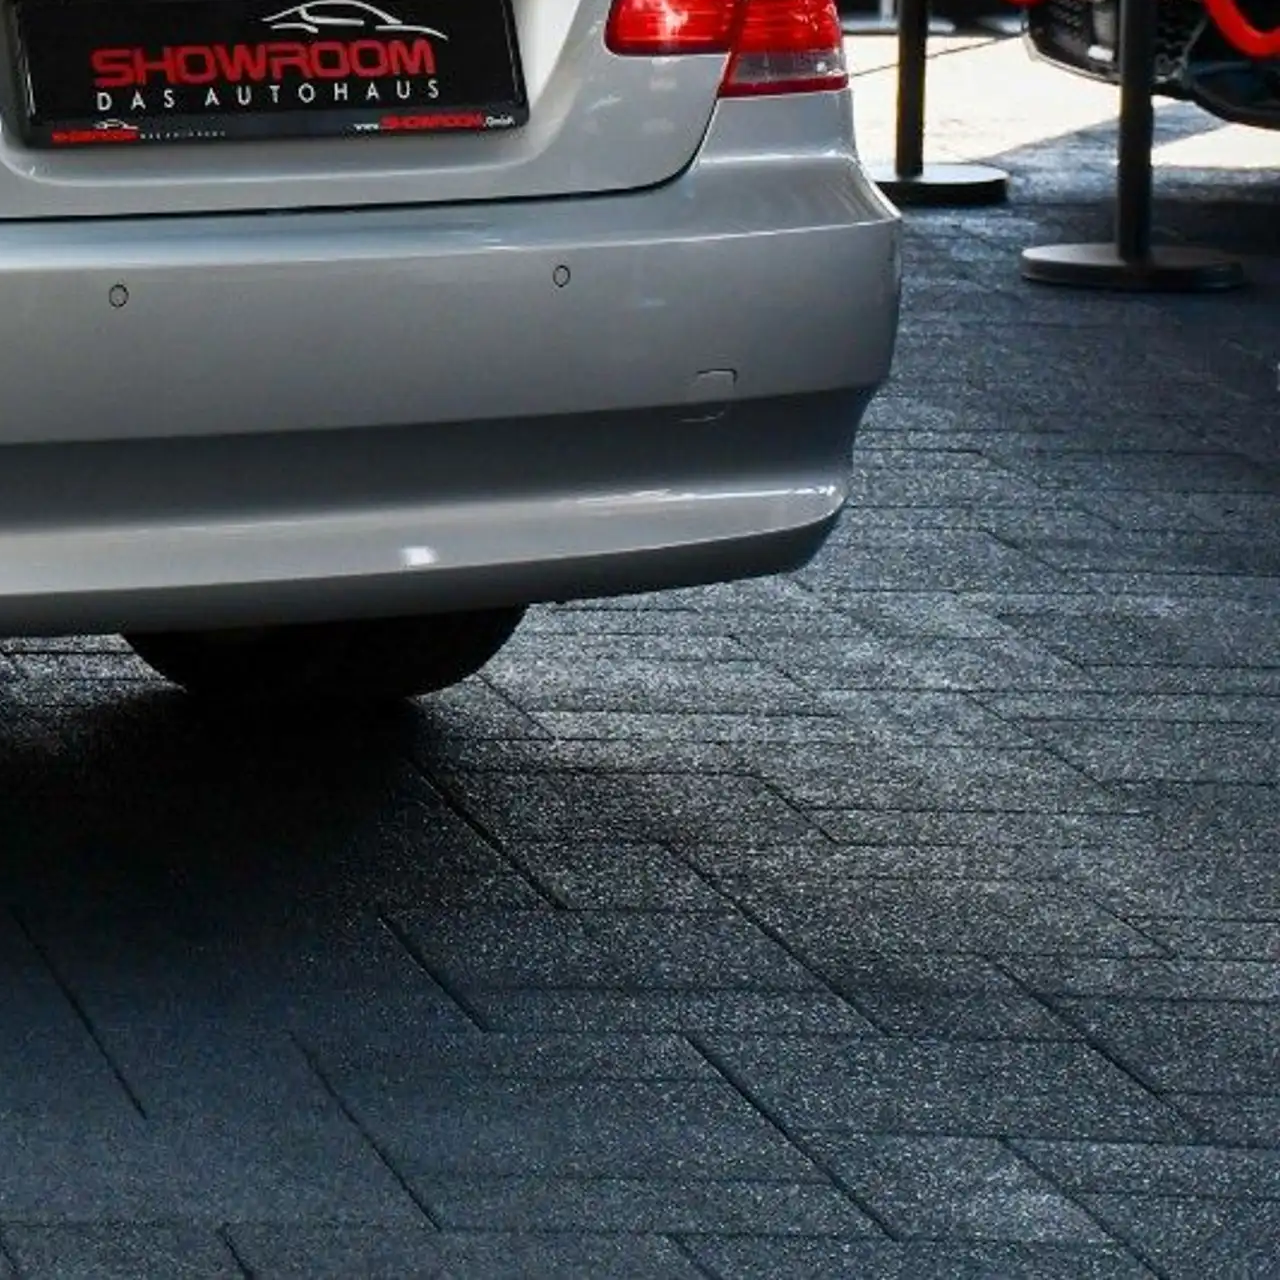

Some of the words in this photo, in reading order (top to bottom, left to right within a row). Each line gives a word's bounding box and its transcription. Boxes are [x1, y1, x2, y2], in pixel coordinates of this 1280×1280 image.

[93, 40, 436, 88] SHOWROOM
[96, 89, 176, 113] DAS
[206, 78, 441, 106] AUTOHAUS
